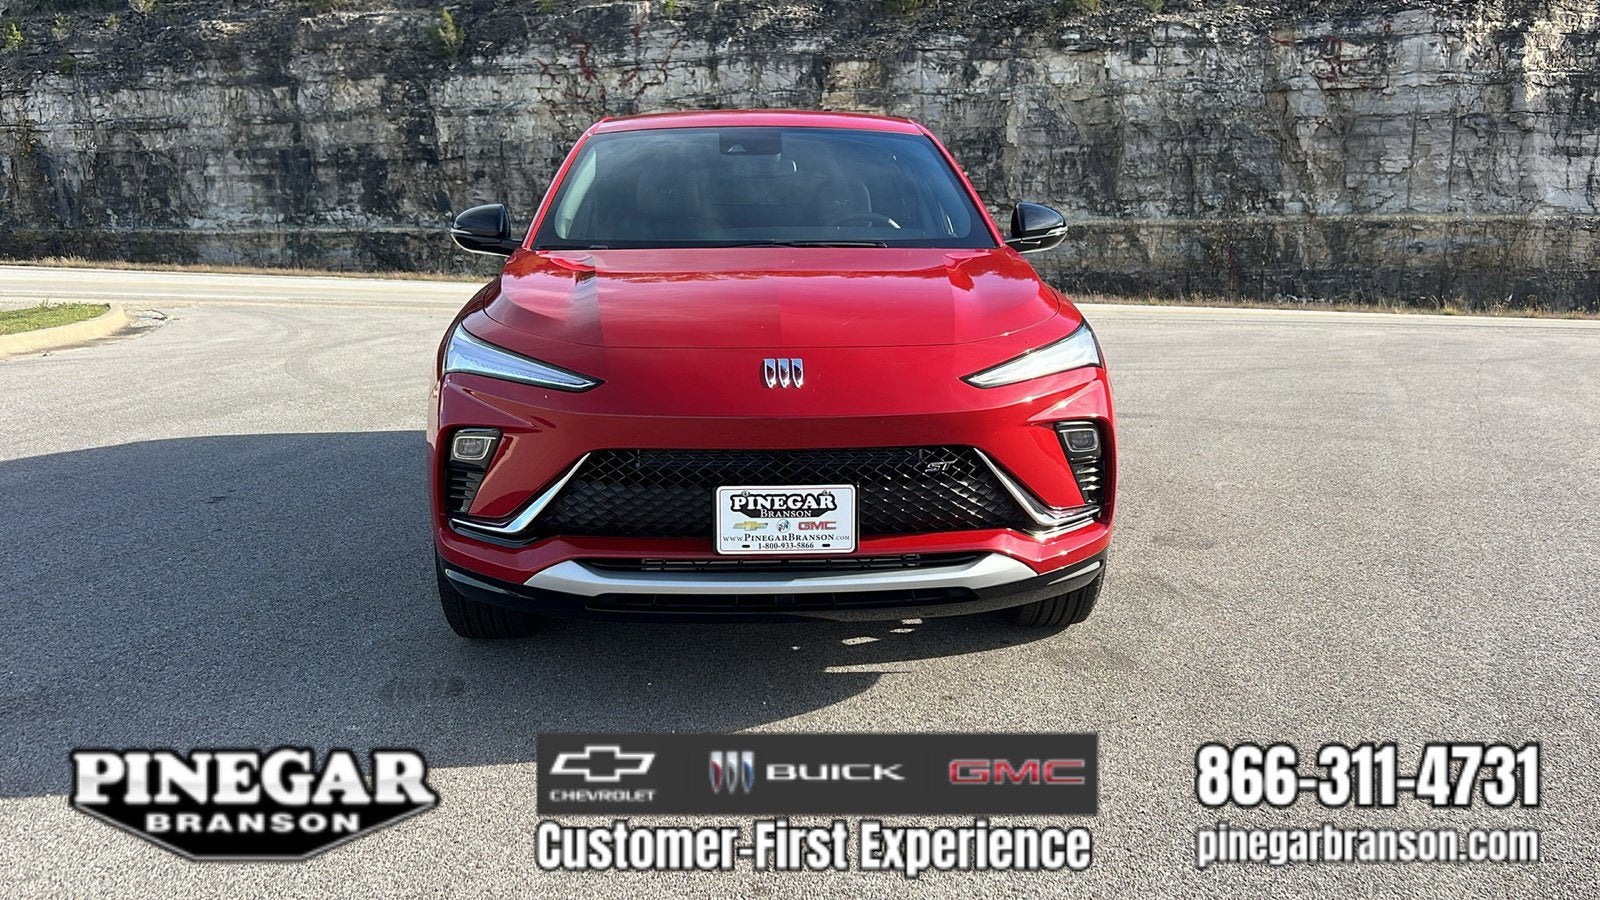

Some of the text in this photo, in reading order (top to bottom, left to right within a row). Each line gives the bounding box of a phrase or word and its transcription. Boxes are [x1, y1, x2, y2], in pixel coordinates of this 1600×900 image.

[732, 495, 836, 510] PINEGAR
[760, 508, 812, 518] BRANSON
[798, 521, 837, 530] GMC
[758, 542, 814, 550] 1-800-933-5866
